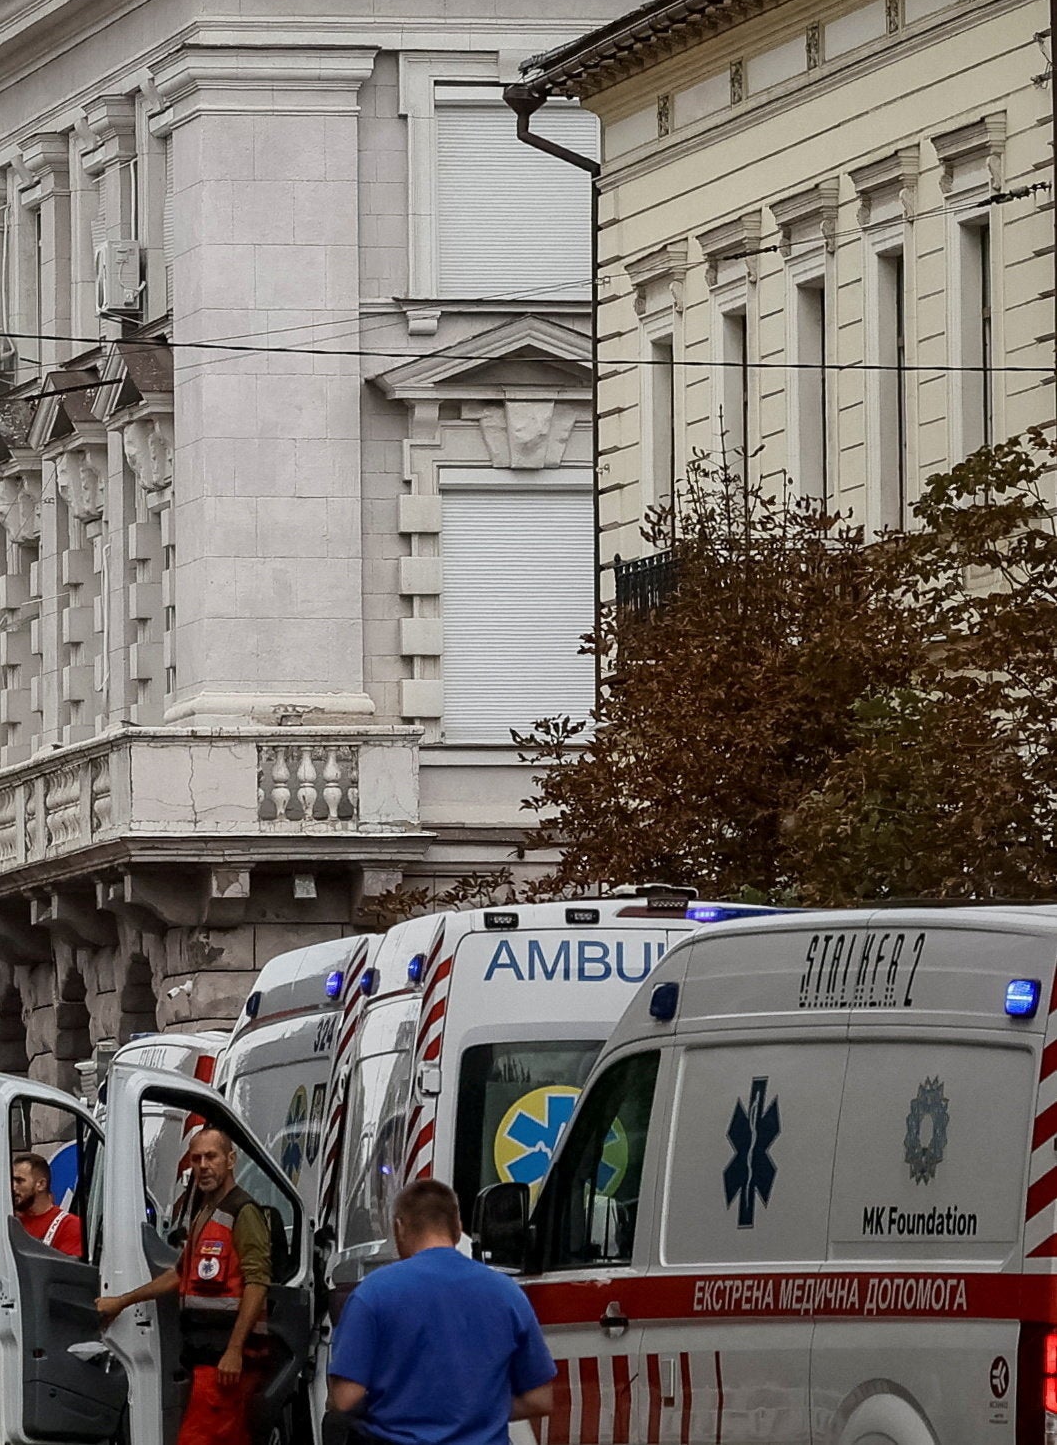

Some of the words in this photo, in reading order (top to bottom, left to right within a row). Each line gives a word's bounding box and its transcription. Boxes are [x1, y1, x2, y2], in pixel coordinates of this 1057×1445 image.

[904, 933, 926, 1007] 2
[313, 1015, 337, 1052] 324
[862, 1206, 886, 1235] MK
[887, 1205, 978, 1236] Foundation
[693, 1279, 774, 1311] ЕКСТРЕНА
[778, 1278, 859, 1316] МЕДИЧНА
[864, 1278, 968, 1316] ДОПОМОГА
